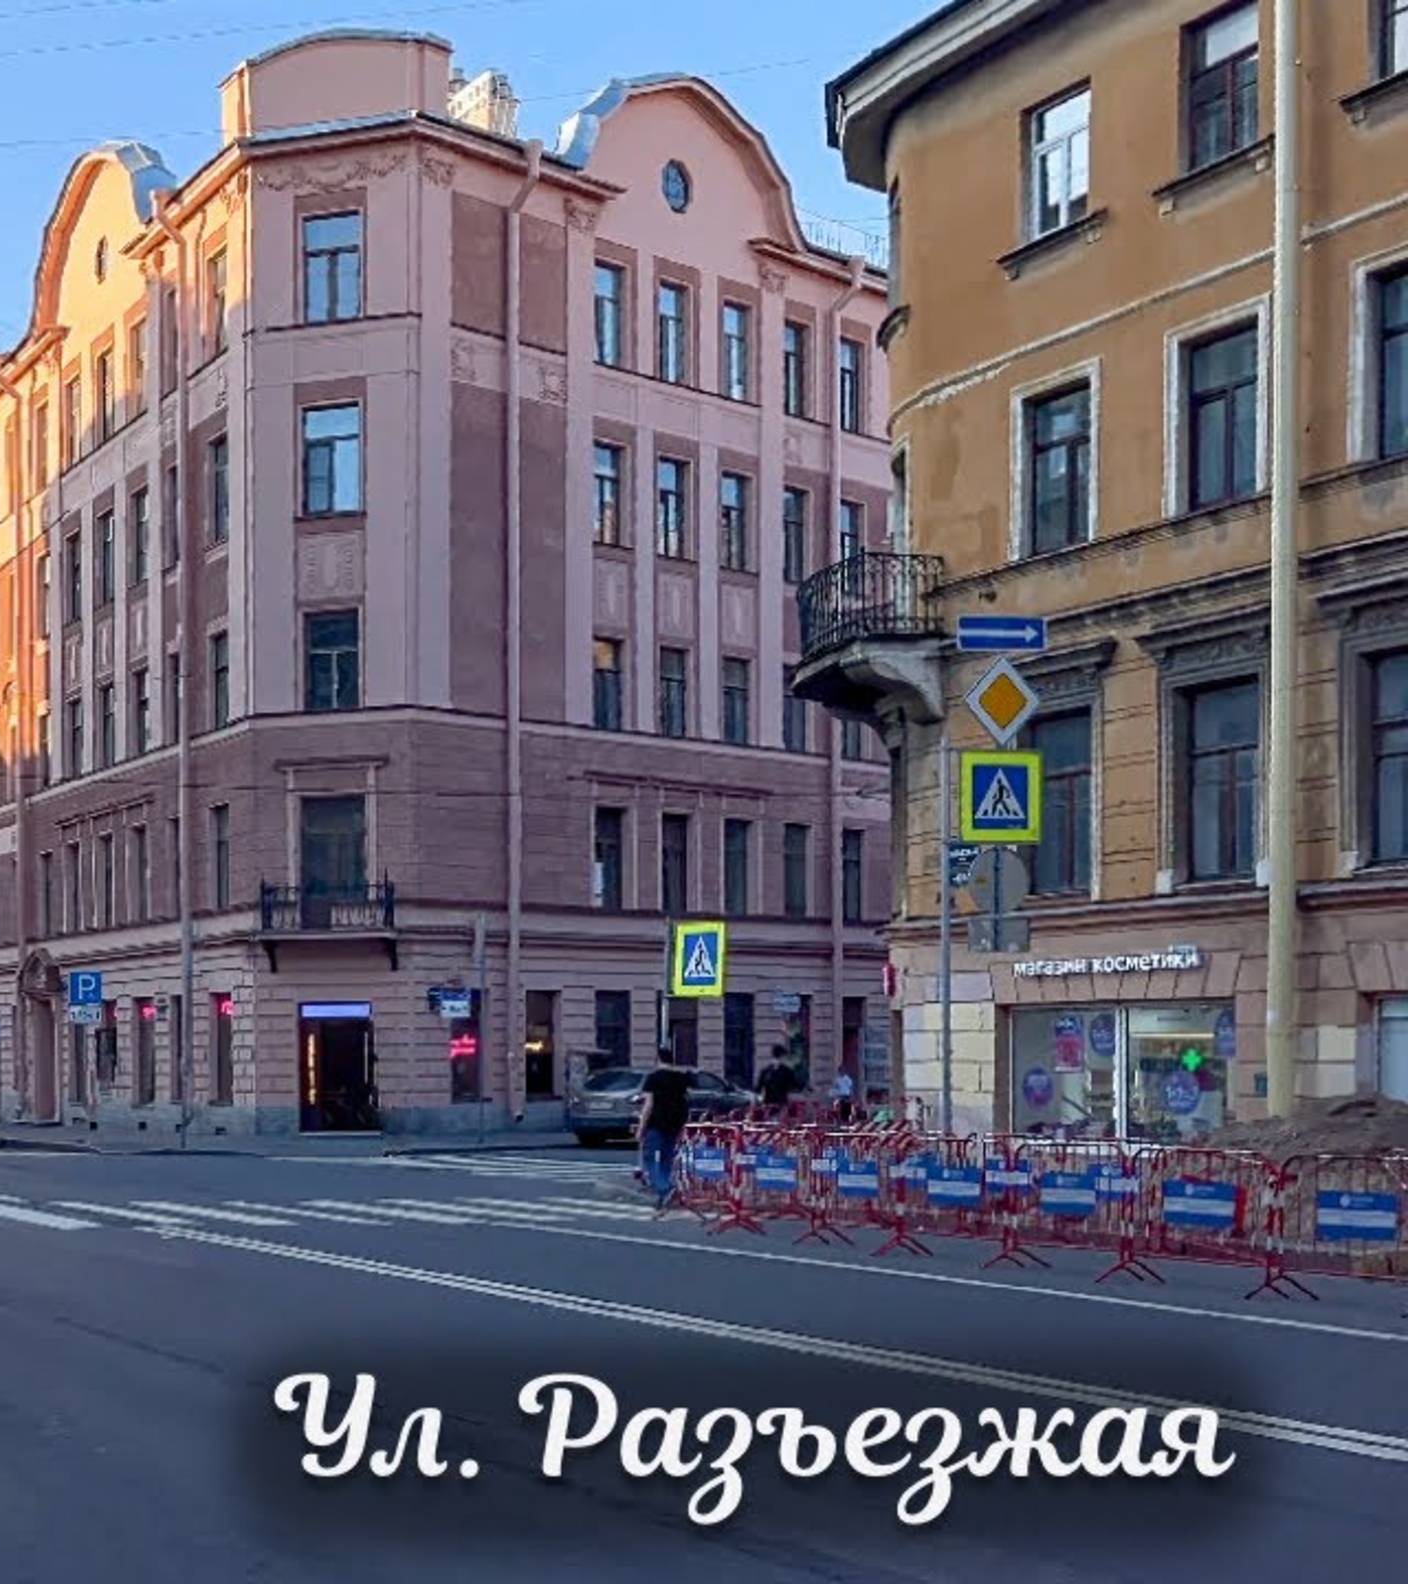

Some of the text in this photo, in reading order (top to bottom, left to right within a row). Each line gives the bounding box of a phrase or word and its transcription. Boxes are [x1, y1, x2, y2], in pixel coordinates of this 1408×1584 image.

[1013, 952, 1200, 977] магазин косметики
[78, 974, 96, 1000] P
